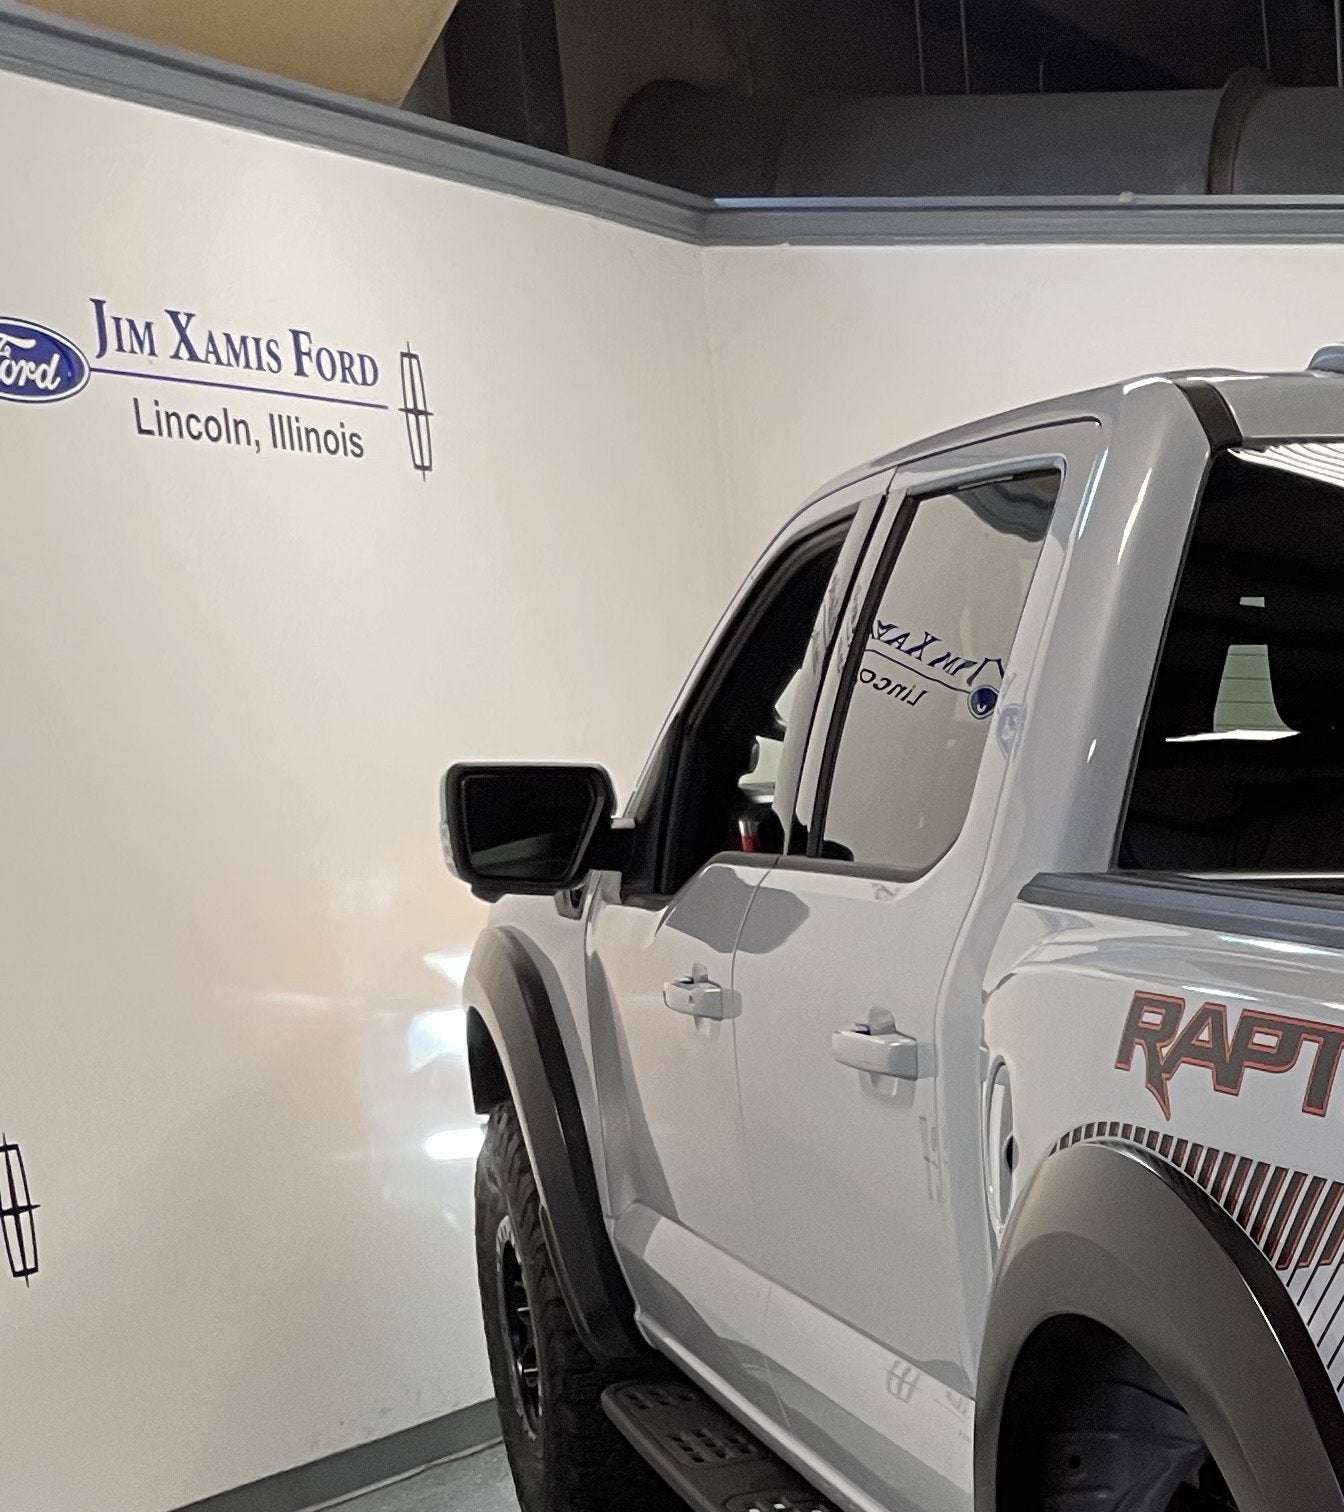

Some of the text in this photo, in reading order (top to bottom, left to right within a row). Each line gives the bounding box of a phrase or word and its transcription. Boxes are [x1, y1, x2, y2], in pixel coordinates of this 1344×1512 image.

[90, 297, 379, 387] JIM XAMIS FORD
[133, 398, 365, 459] Lincoln, Illinois
